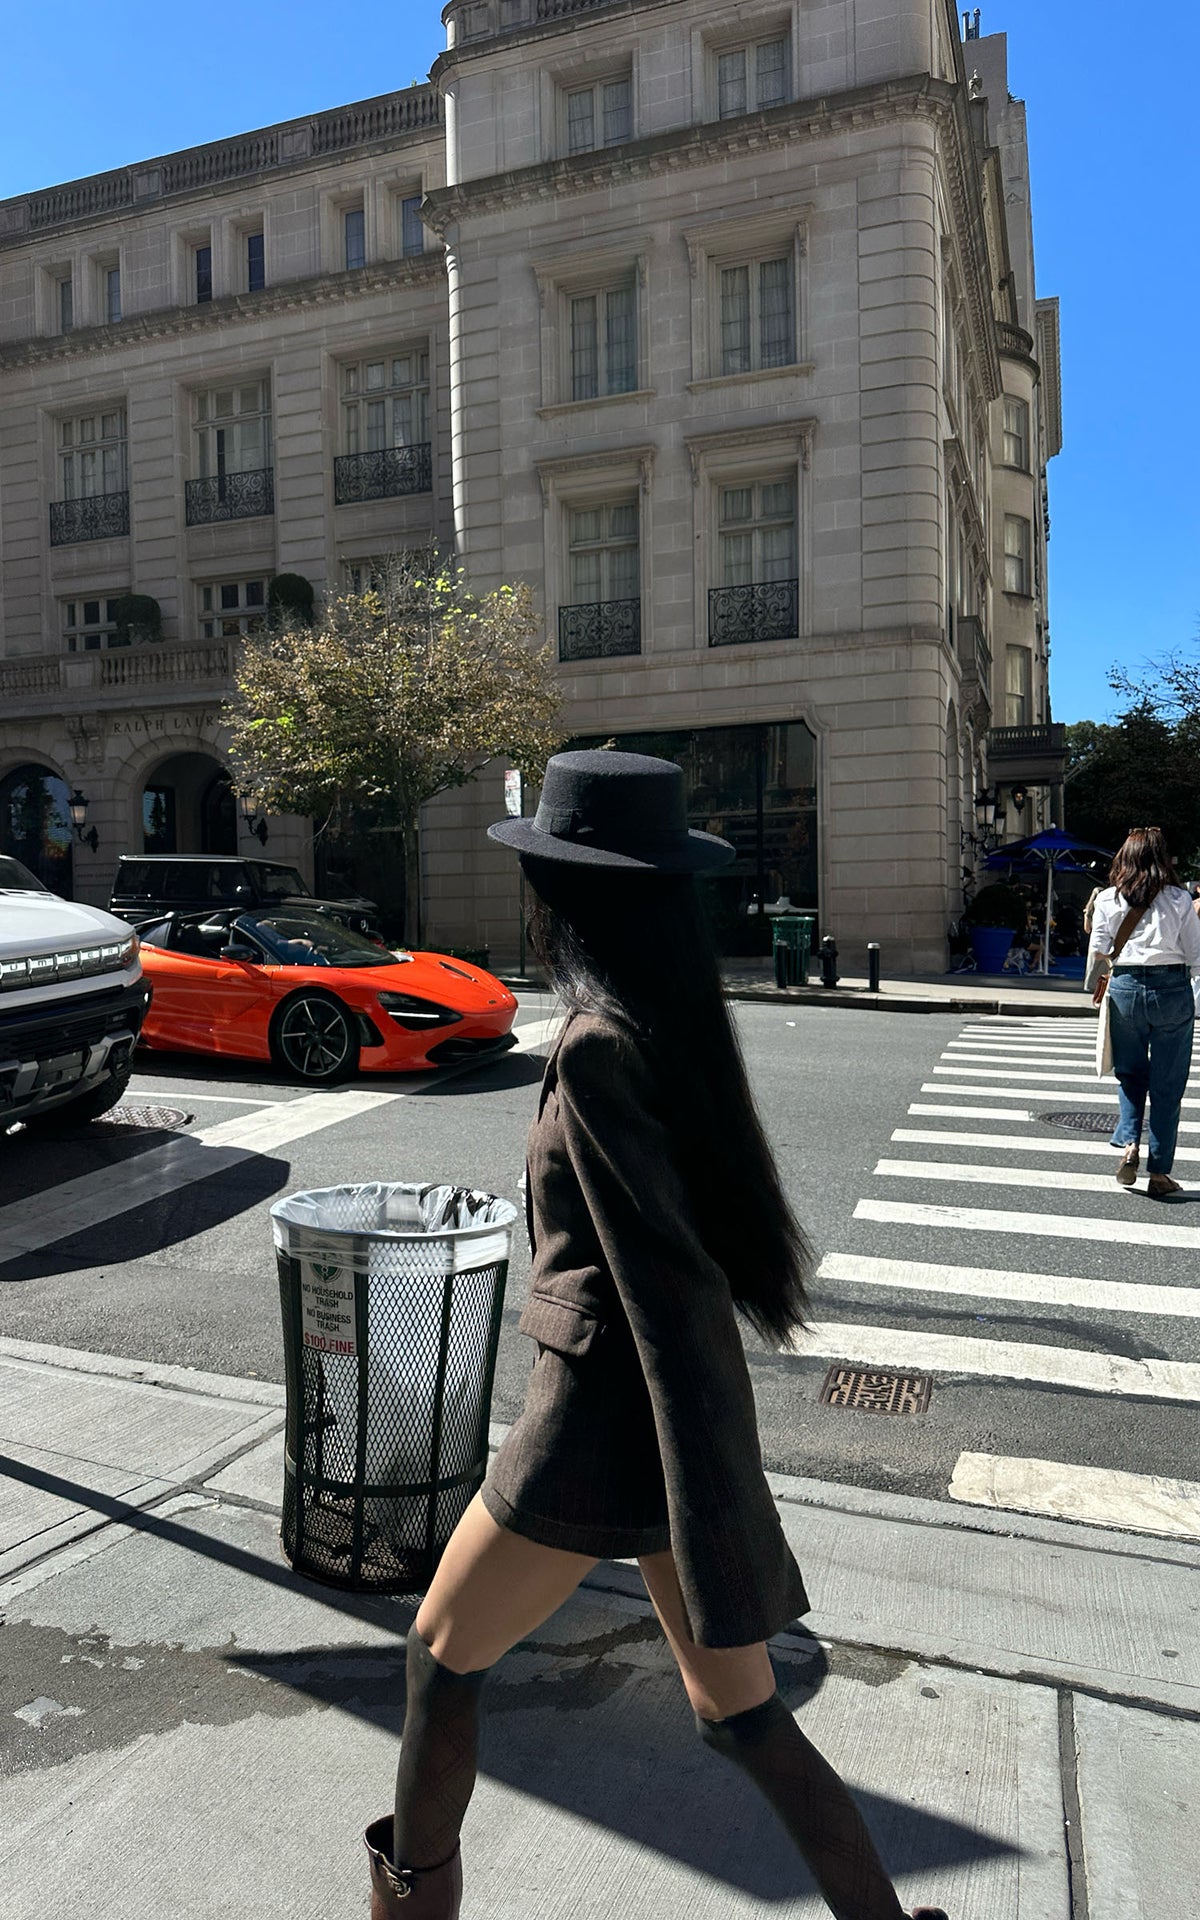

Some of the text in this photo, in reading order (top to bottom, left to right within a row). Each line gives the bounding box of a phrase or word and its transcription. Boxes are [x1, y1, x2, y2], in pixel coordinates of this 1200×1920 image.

[113, 715, 222, 733] RALPH LAUR
[303, 1284, 353, 1300] NO HOUSEHOLD
[316, 1297, 339, 1308] TRASH
[307, 1308, 351, 1324] NO BUSINESS
[316, 1320, 340, 1332] TRASH
[304, 1332, 355, 1354] $100 FINE
